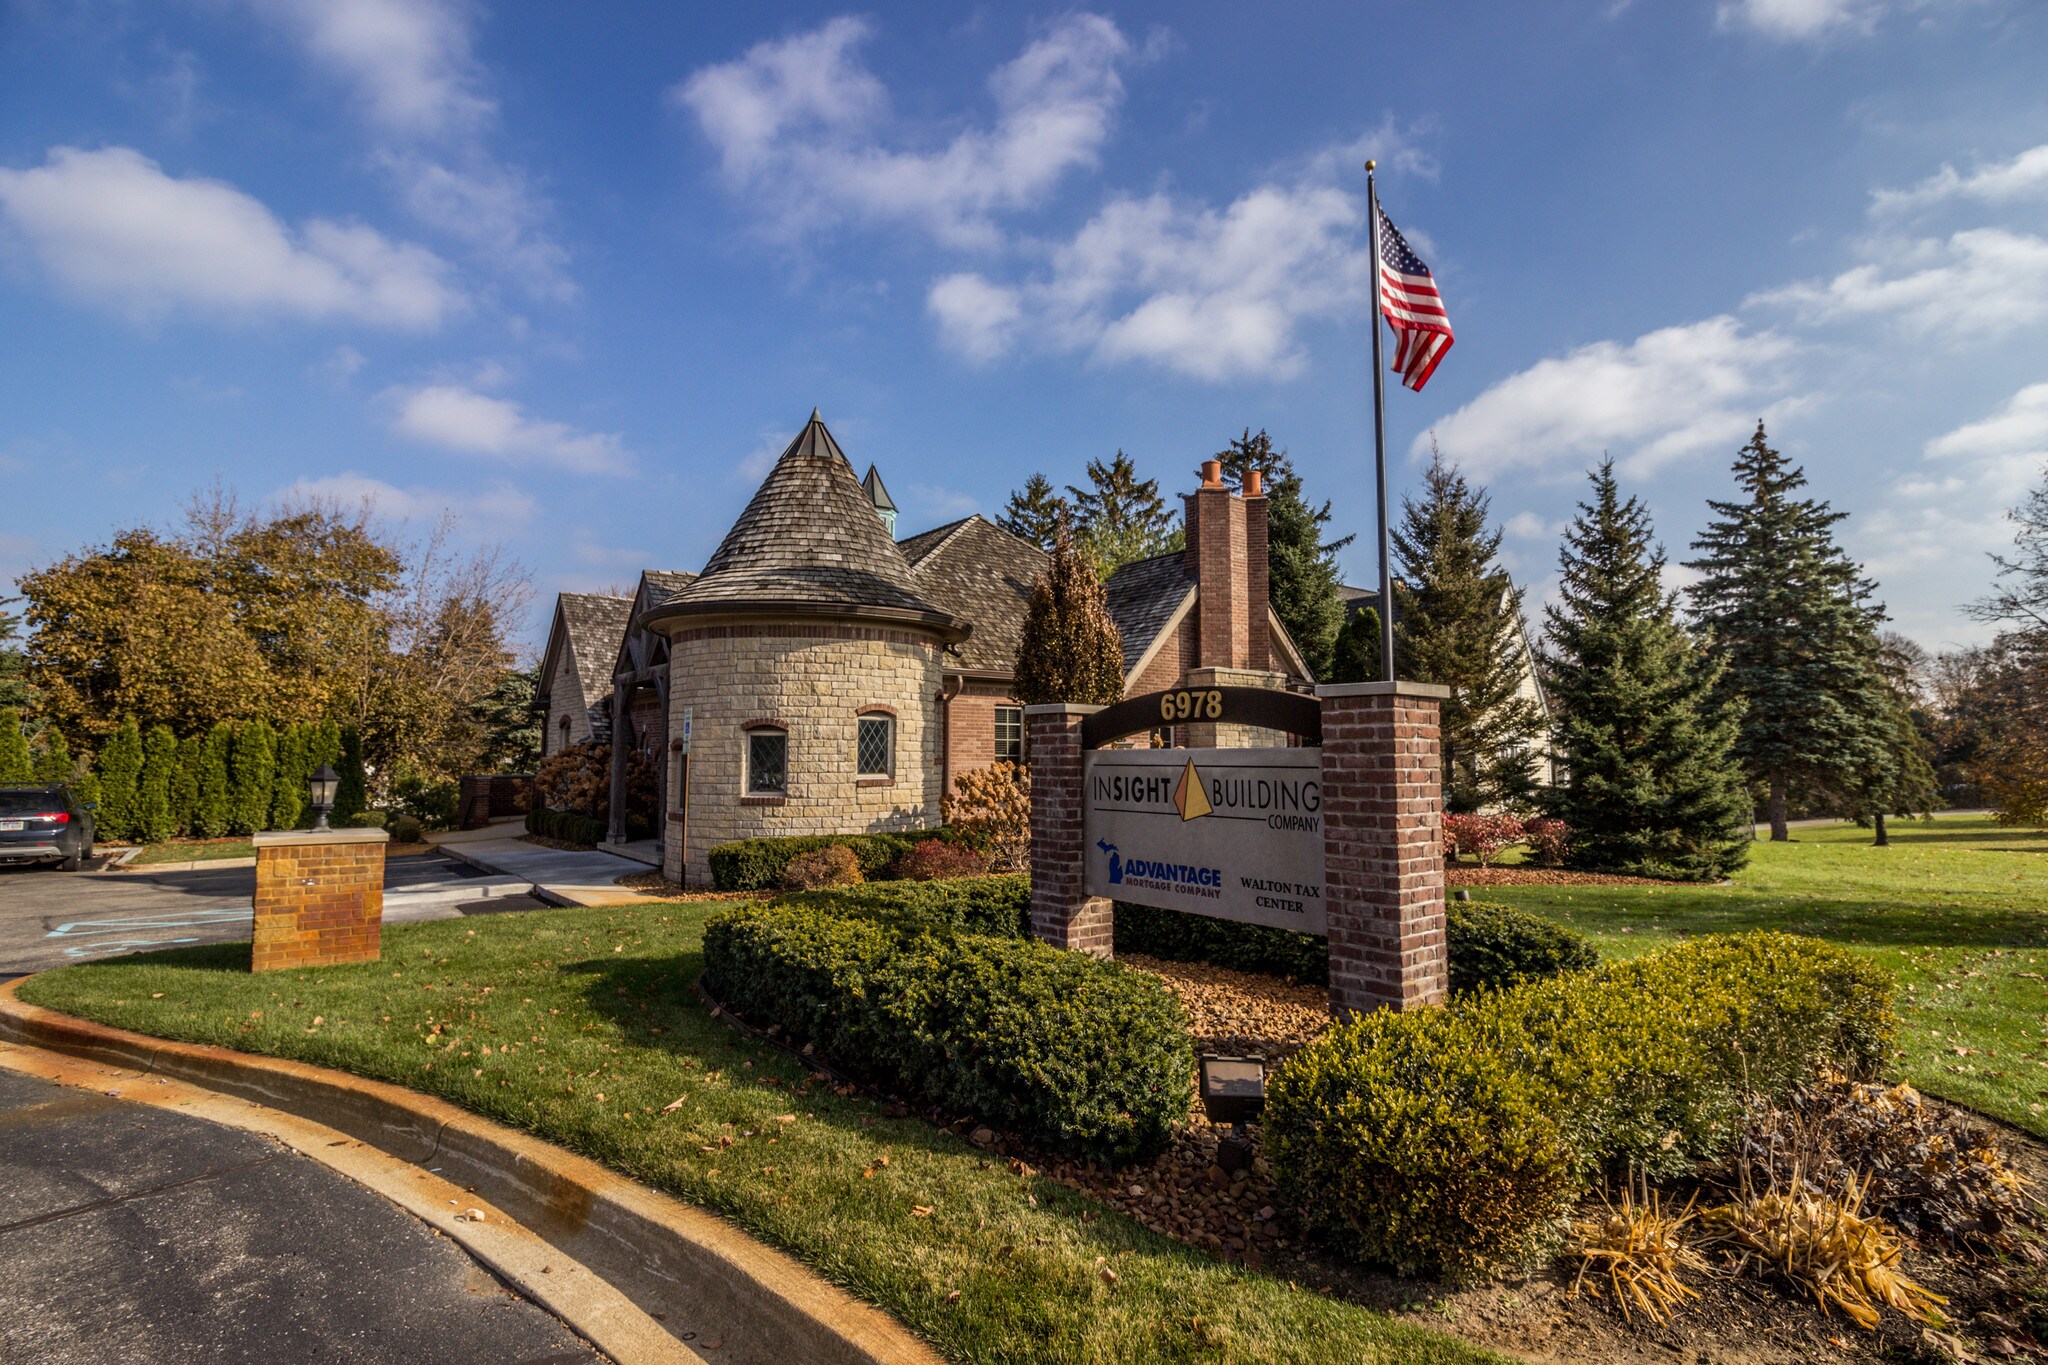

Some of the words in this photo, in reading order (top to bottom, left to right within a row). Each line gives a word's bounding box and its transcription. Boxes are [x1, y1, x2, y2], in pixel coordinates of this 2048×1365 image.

[1161, 690, 1222, 720] 6978
[1093, 776, 1171, 804] INSIGHT
[1213, 778, 1320, 812] BUILDING
[1268, 814, 1320, 832] COMPANY
[1125, 859, 1221, 887] ADVANTAGE
[1126, 878, 1171, 892] MORTGAGE
[1175, 884, 1220, 899] COMPANY
[1240, 877, 1292, 894] WALTON
[1294, 884, 1320, 898] TAX
[1256, 896, 1304, 913] CENTER
